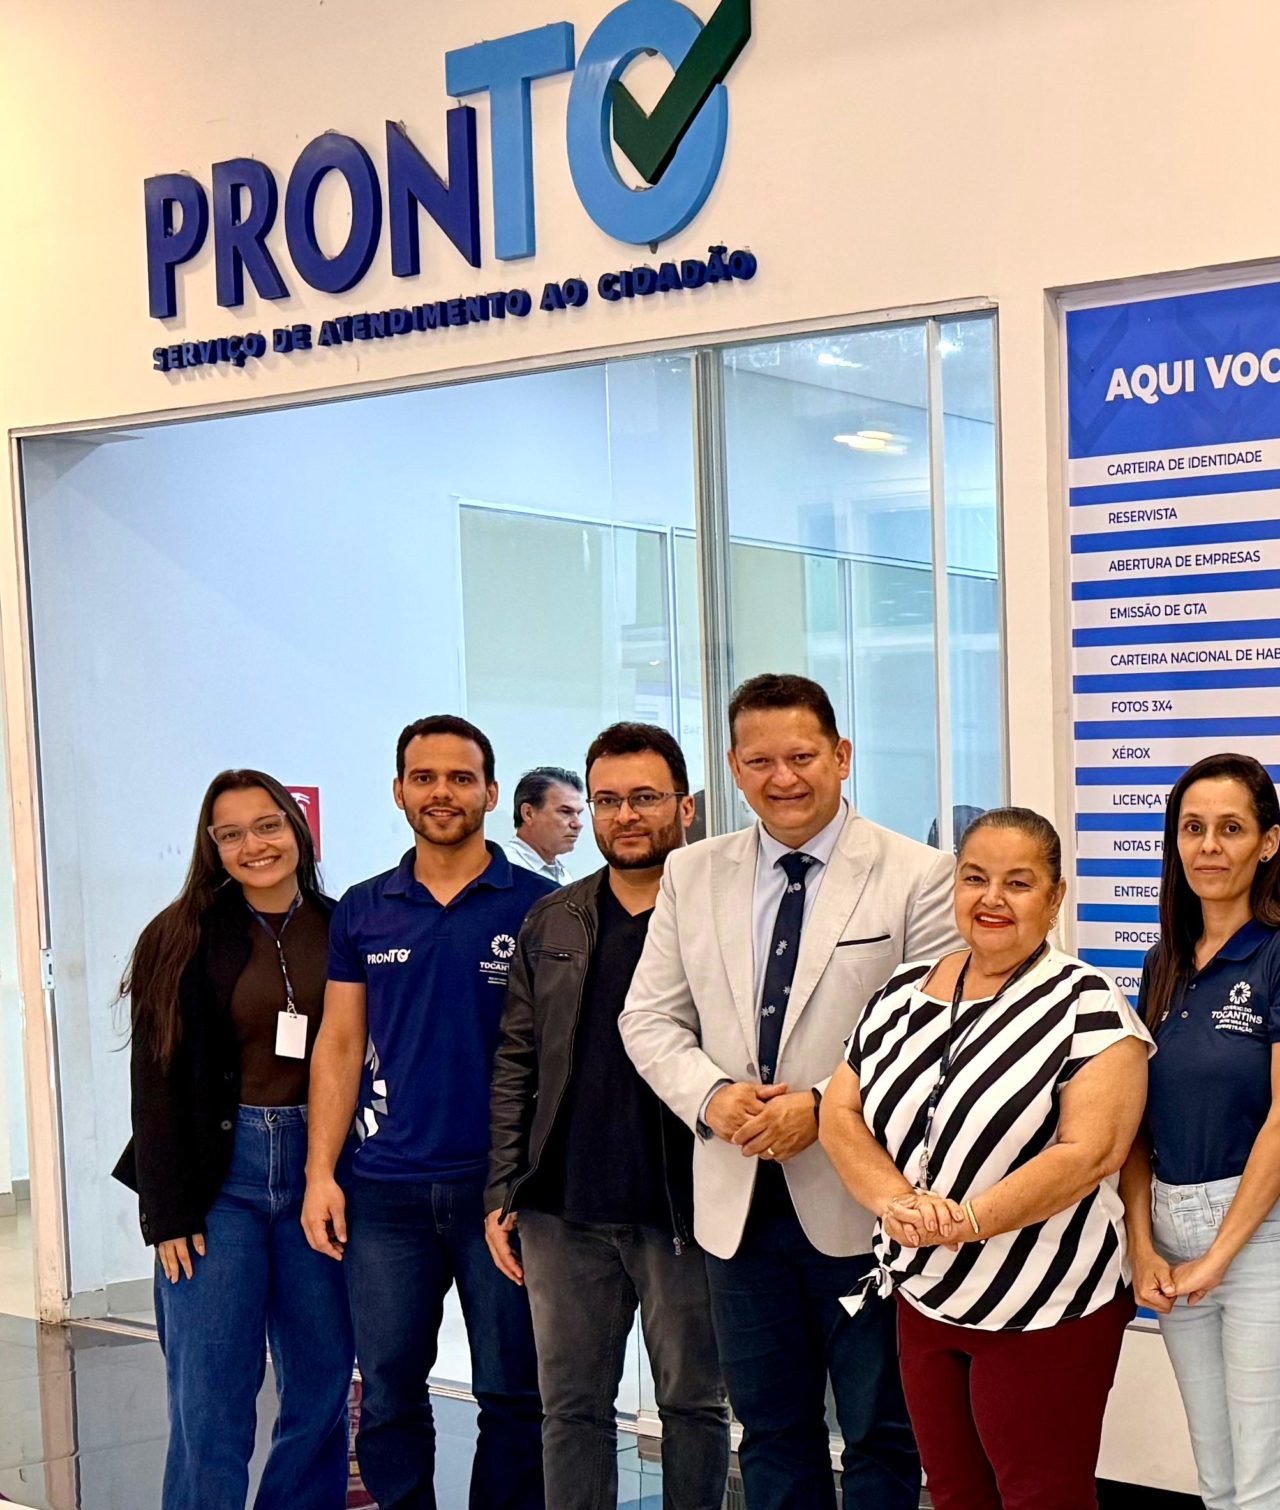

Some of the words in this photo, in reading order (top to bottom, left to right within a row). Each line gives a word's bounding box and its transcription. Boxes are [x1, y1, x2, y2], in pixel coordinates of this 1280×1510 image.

[144, 0, 740, 319] PRONTO
[153, 332, 266, 371] SERVIÇO
[273, 324, 312, 353] DE
[318, 289, 532, 346] ATENDIMENTO
[540, 278, 588, 311] AO
[598, 245, 757, 301] CIDADÃO
[1105, 359, 1194, 404] AQUI
[1107, 459, 1165, 476] CARTEIRA
[1168, 457, 1184, 470] DE
[1188, 450, 1262, 469] IDENTIDADE
[1108, 507, 1177, 524] RESERVISTA
[1109, 556, 1172, 572] ABERTURA
[1176, 555, 1191, 567] DE
[1196, 550, 1260, 566] EMPRESAS
[1110, 603, 1161, 619] EMISSÃO
[1164, 604, 1180, 617] DE
[1184, 603, 1207, 616] GTA
[1110, 652, 1168, 667] CARTEIRA
[1171, 650, 1232, 665] NACIONAL
[1236, 648, 1252, 662] DE
[1111, 700, 1149, 713] FOTOS
[1152, 700, 1173, 712] 3X4
[1112, 745, 1150, 760] XÉROX
[1113, 793, 1161, 808] LICENÇA
[1113, 840, 1151, 852] NOTAS
[1114, 886, 1158, 898] ENTREG
[1115, 931, 1160, 944] PROCES
[367, 949, 410, 964] PRONTO
[1211, 1010, 1263, 1025] TOCANTINS
